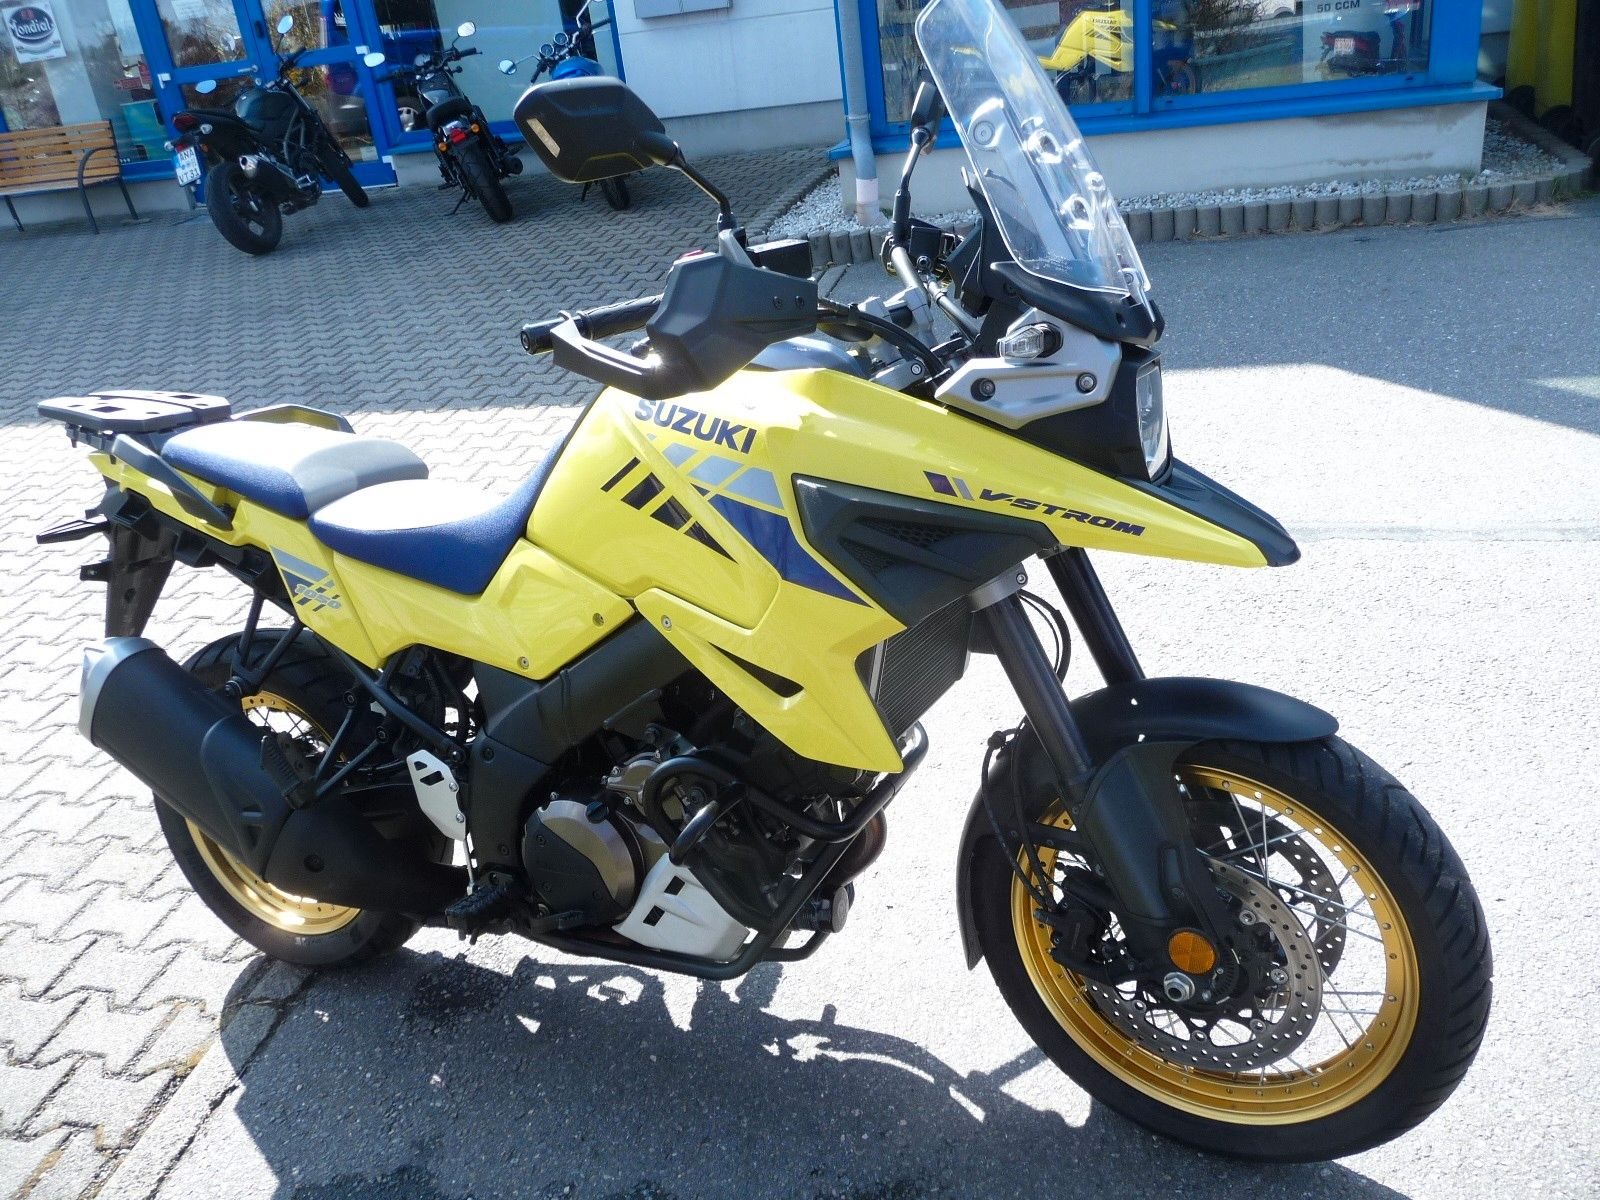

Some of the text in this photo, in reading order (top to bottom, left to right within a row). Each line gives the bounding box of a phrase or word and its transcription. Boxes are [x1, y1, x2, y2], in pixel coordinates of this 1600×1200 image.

[1317, 0, 1360, 13] 50 CCM
[634, 398, 757, 454] SUZUKI
[979, 488, 1146, 536] V-STROM
